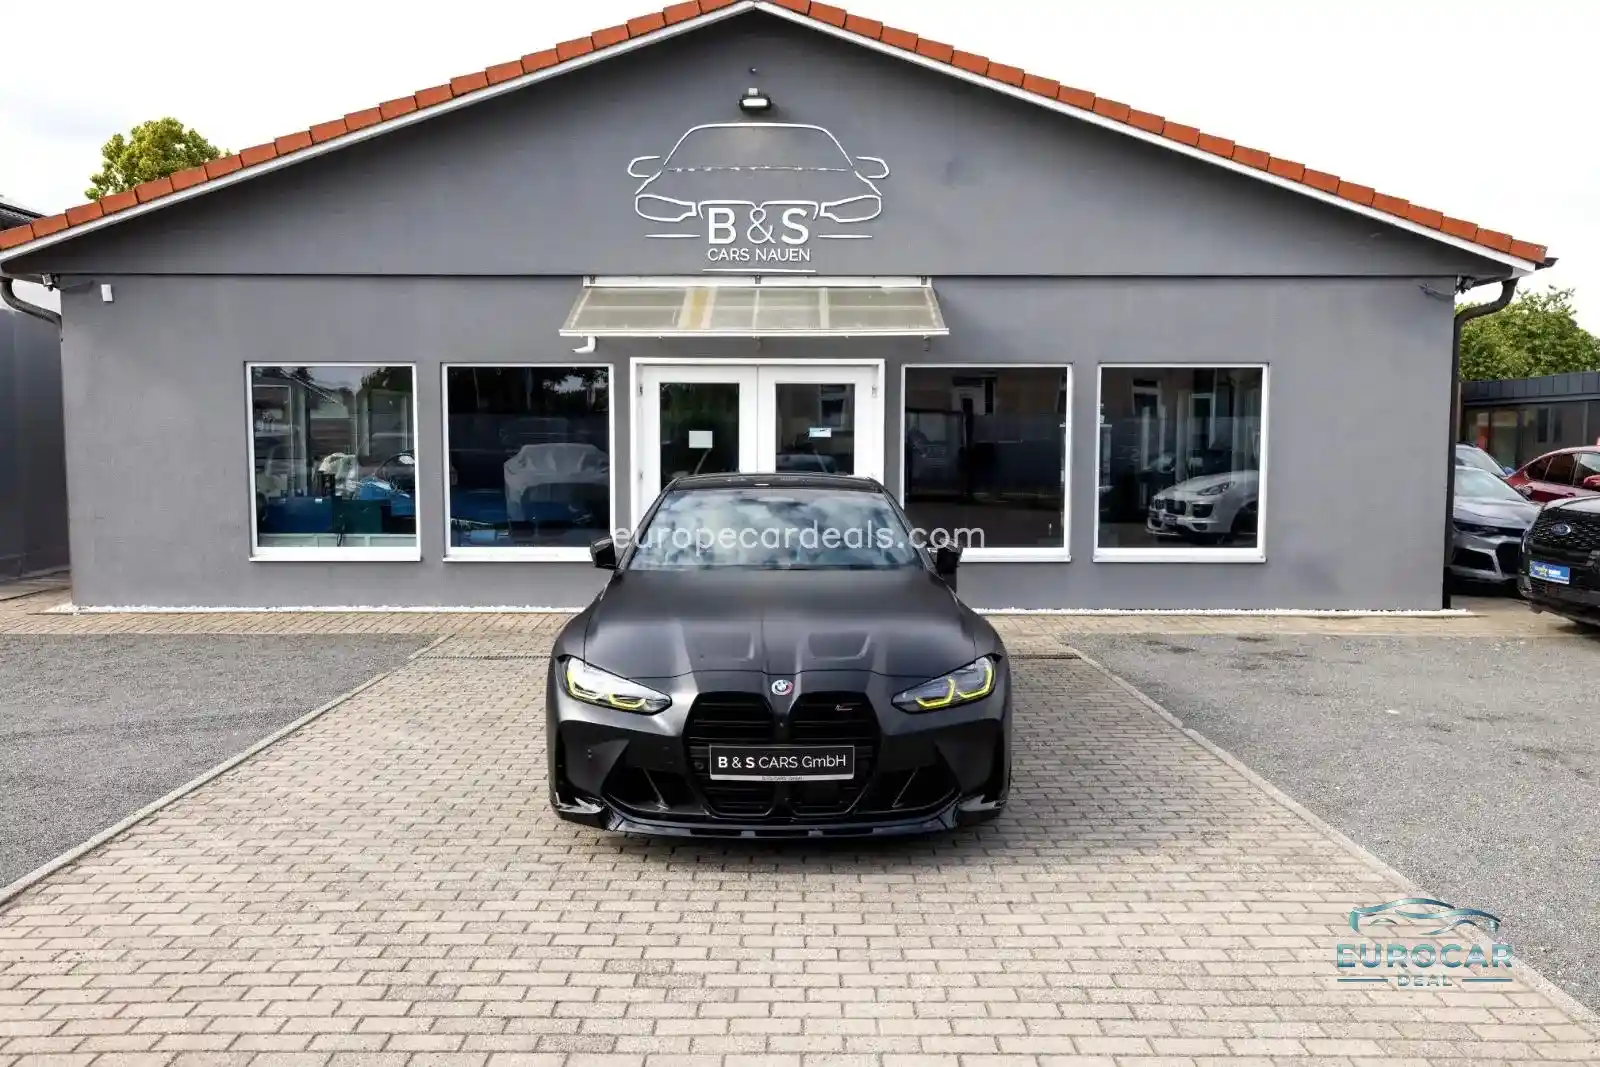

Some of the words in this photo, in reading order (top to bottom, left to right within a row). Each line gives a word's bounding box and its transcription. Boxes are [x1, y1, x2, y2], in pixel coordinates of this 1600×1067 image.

[707, 248, 750, 262] CARS
[755, 247, 811, 262] NAUEN
[718, 756, 728, 768] B
[731, 756, 742, 769] &
[745, 756, 755, 769] S
[758, 756, 799, 769] CARS
[801, 754, 846, 769] GmbH
